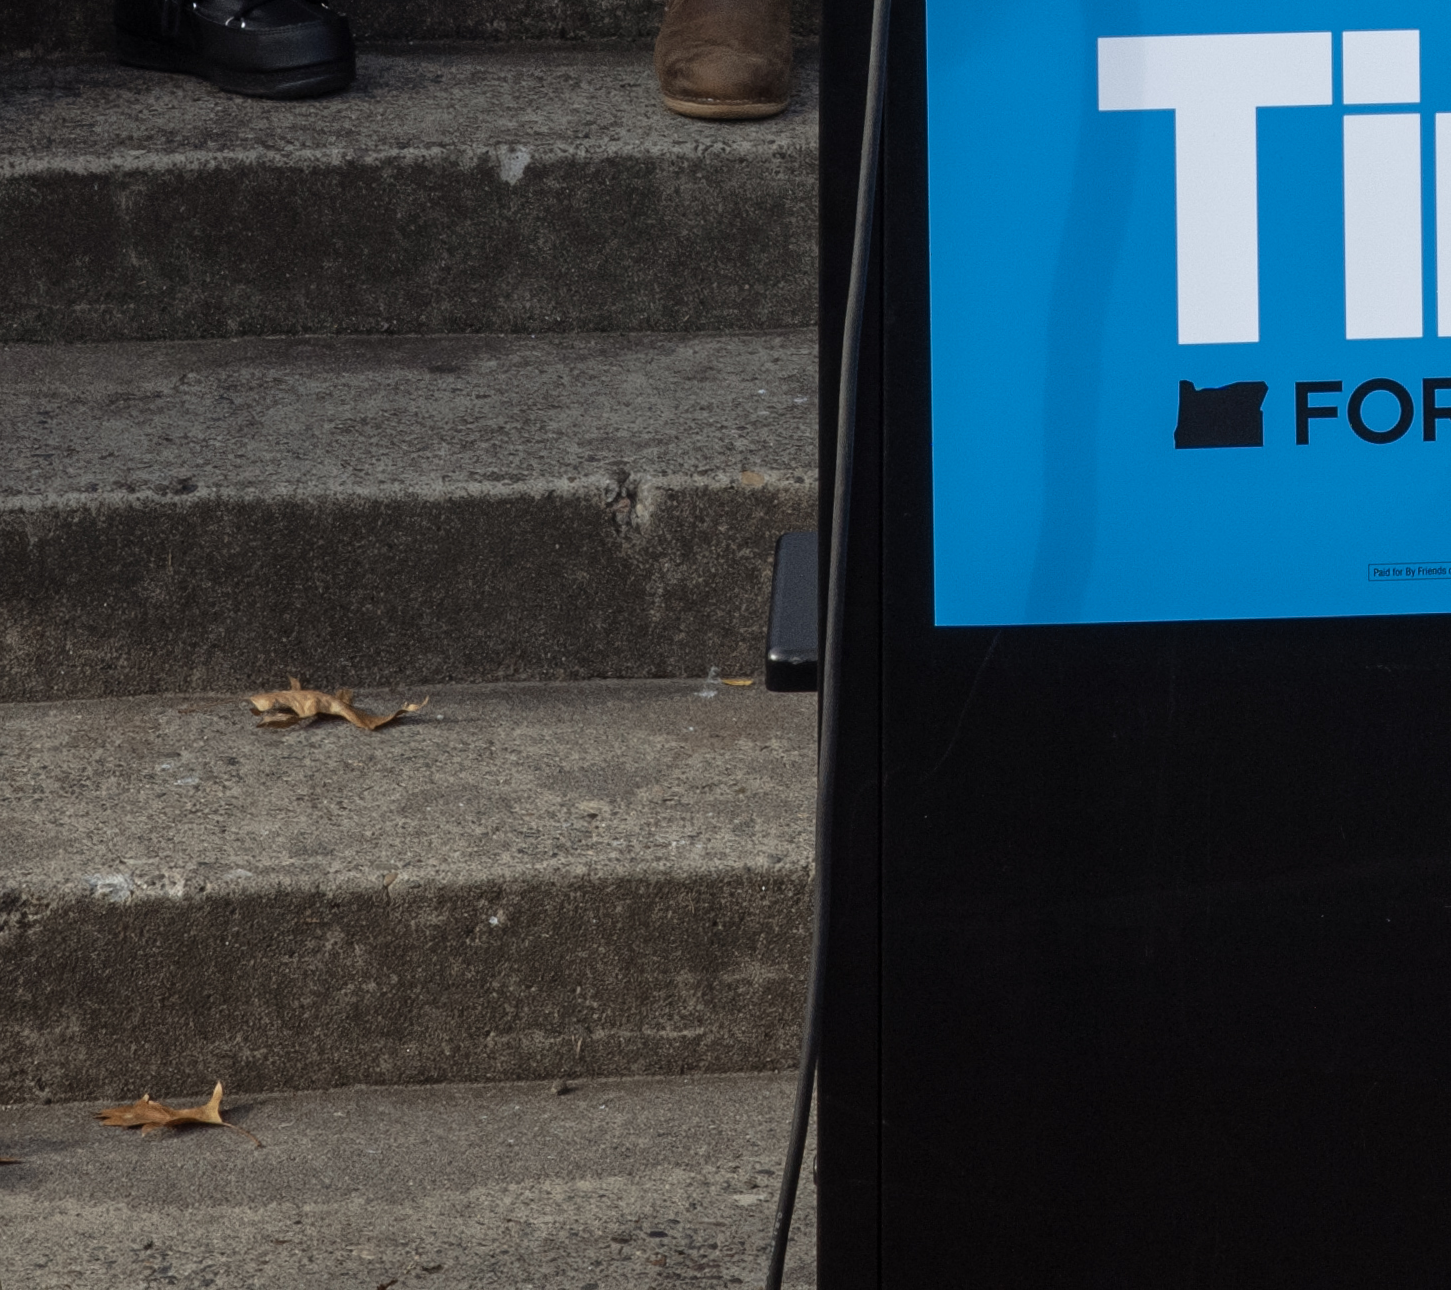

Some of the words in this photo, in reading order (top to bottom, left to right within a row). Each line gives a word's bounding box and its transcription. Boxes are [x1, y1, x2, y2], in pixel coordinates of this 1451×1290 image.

[1374, 568, 1390, 577] Paid
[1393, 568, 1403, 576] for
[1406, 567, 1415, 577] By
[1417, 566, 1447, 576] Friends
